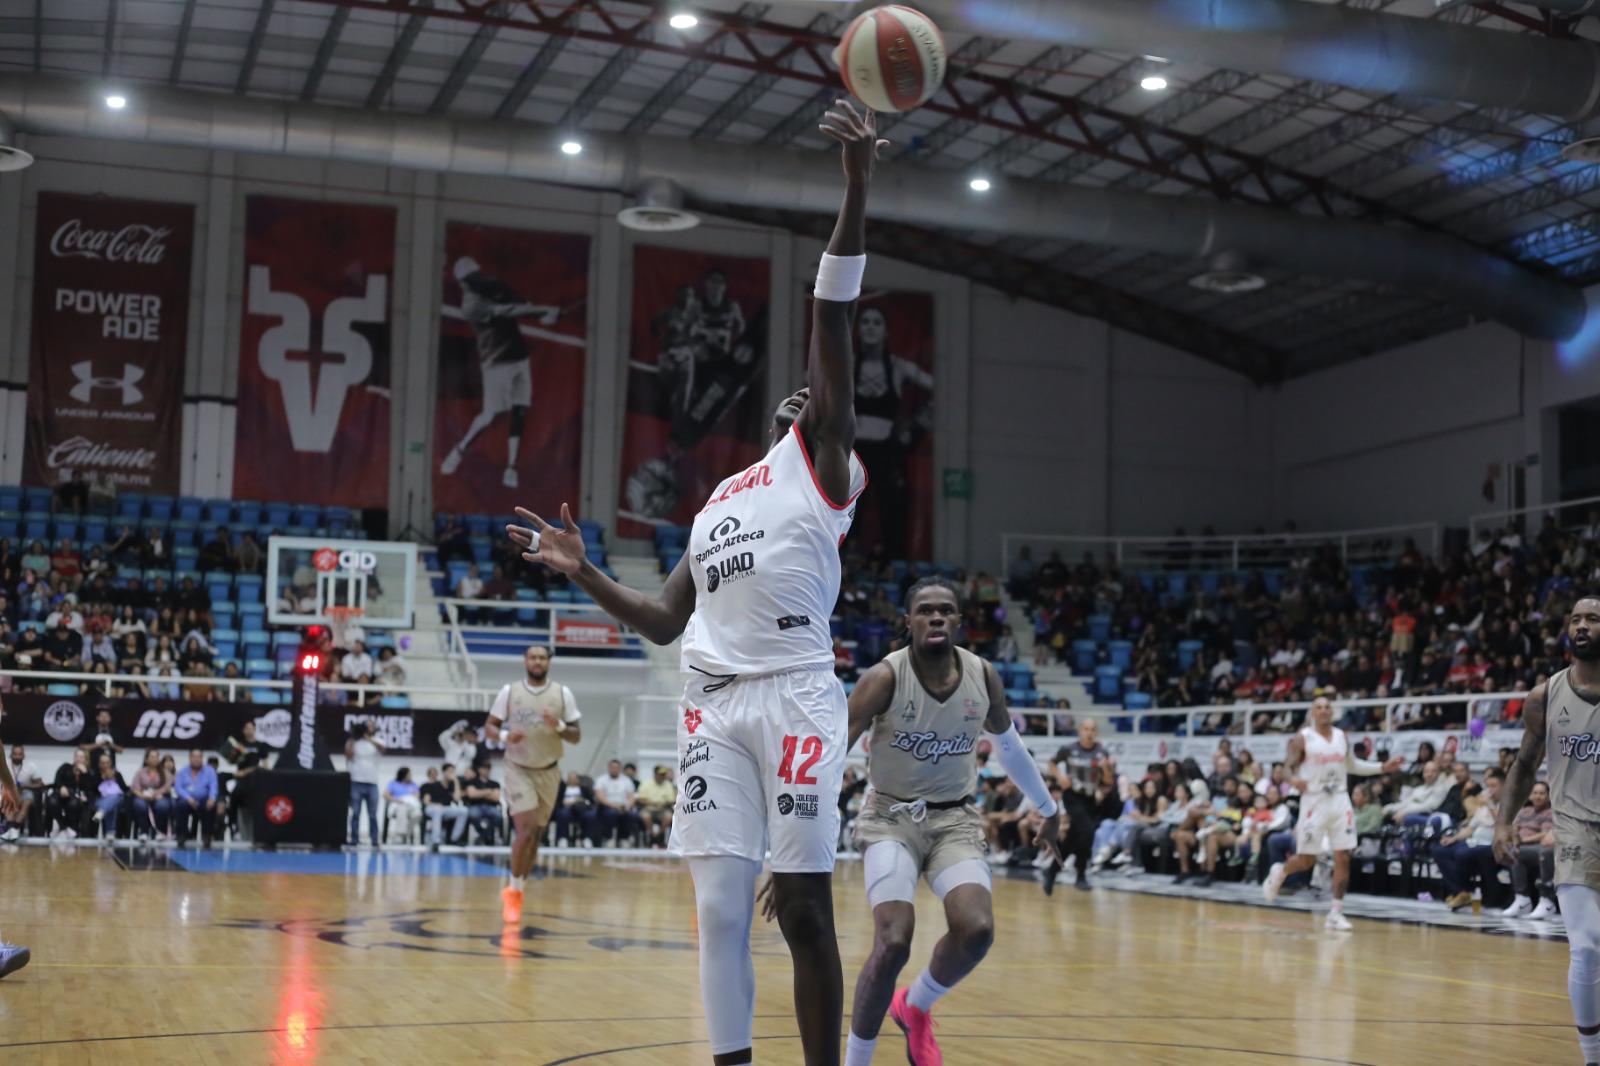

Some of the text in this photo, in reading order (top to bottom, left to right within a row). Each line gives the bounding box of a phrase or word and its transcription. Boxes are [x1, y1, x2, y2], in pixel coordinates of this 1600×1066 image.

[55, 289, 162, 318] POWER
[103, 317, 161, 342] ADE
[55, 408, 156, 421] UNDER ARMOUR
[47, 435, 157, 469] Caliente
[722, 529, 765, 549] Azteca
[338, 550, 377, 570] CID
[695, 544, 721, 564] Banco
[720, 551, 754, 578] UAD
[777, 734, 823, 785] 42
[890, 730, 975, 764] La Capital
[680, 746, 711, 775] Huichol
[683, 799, 717, 815] MEGA
[796, 794, 818, 802] COLEGIO
